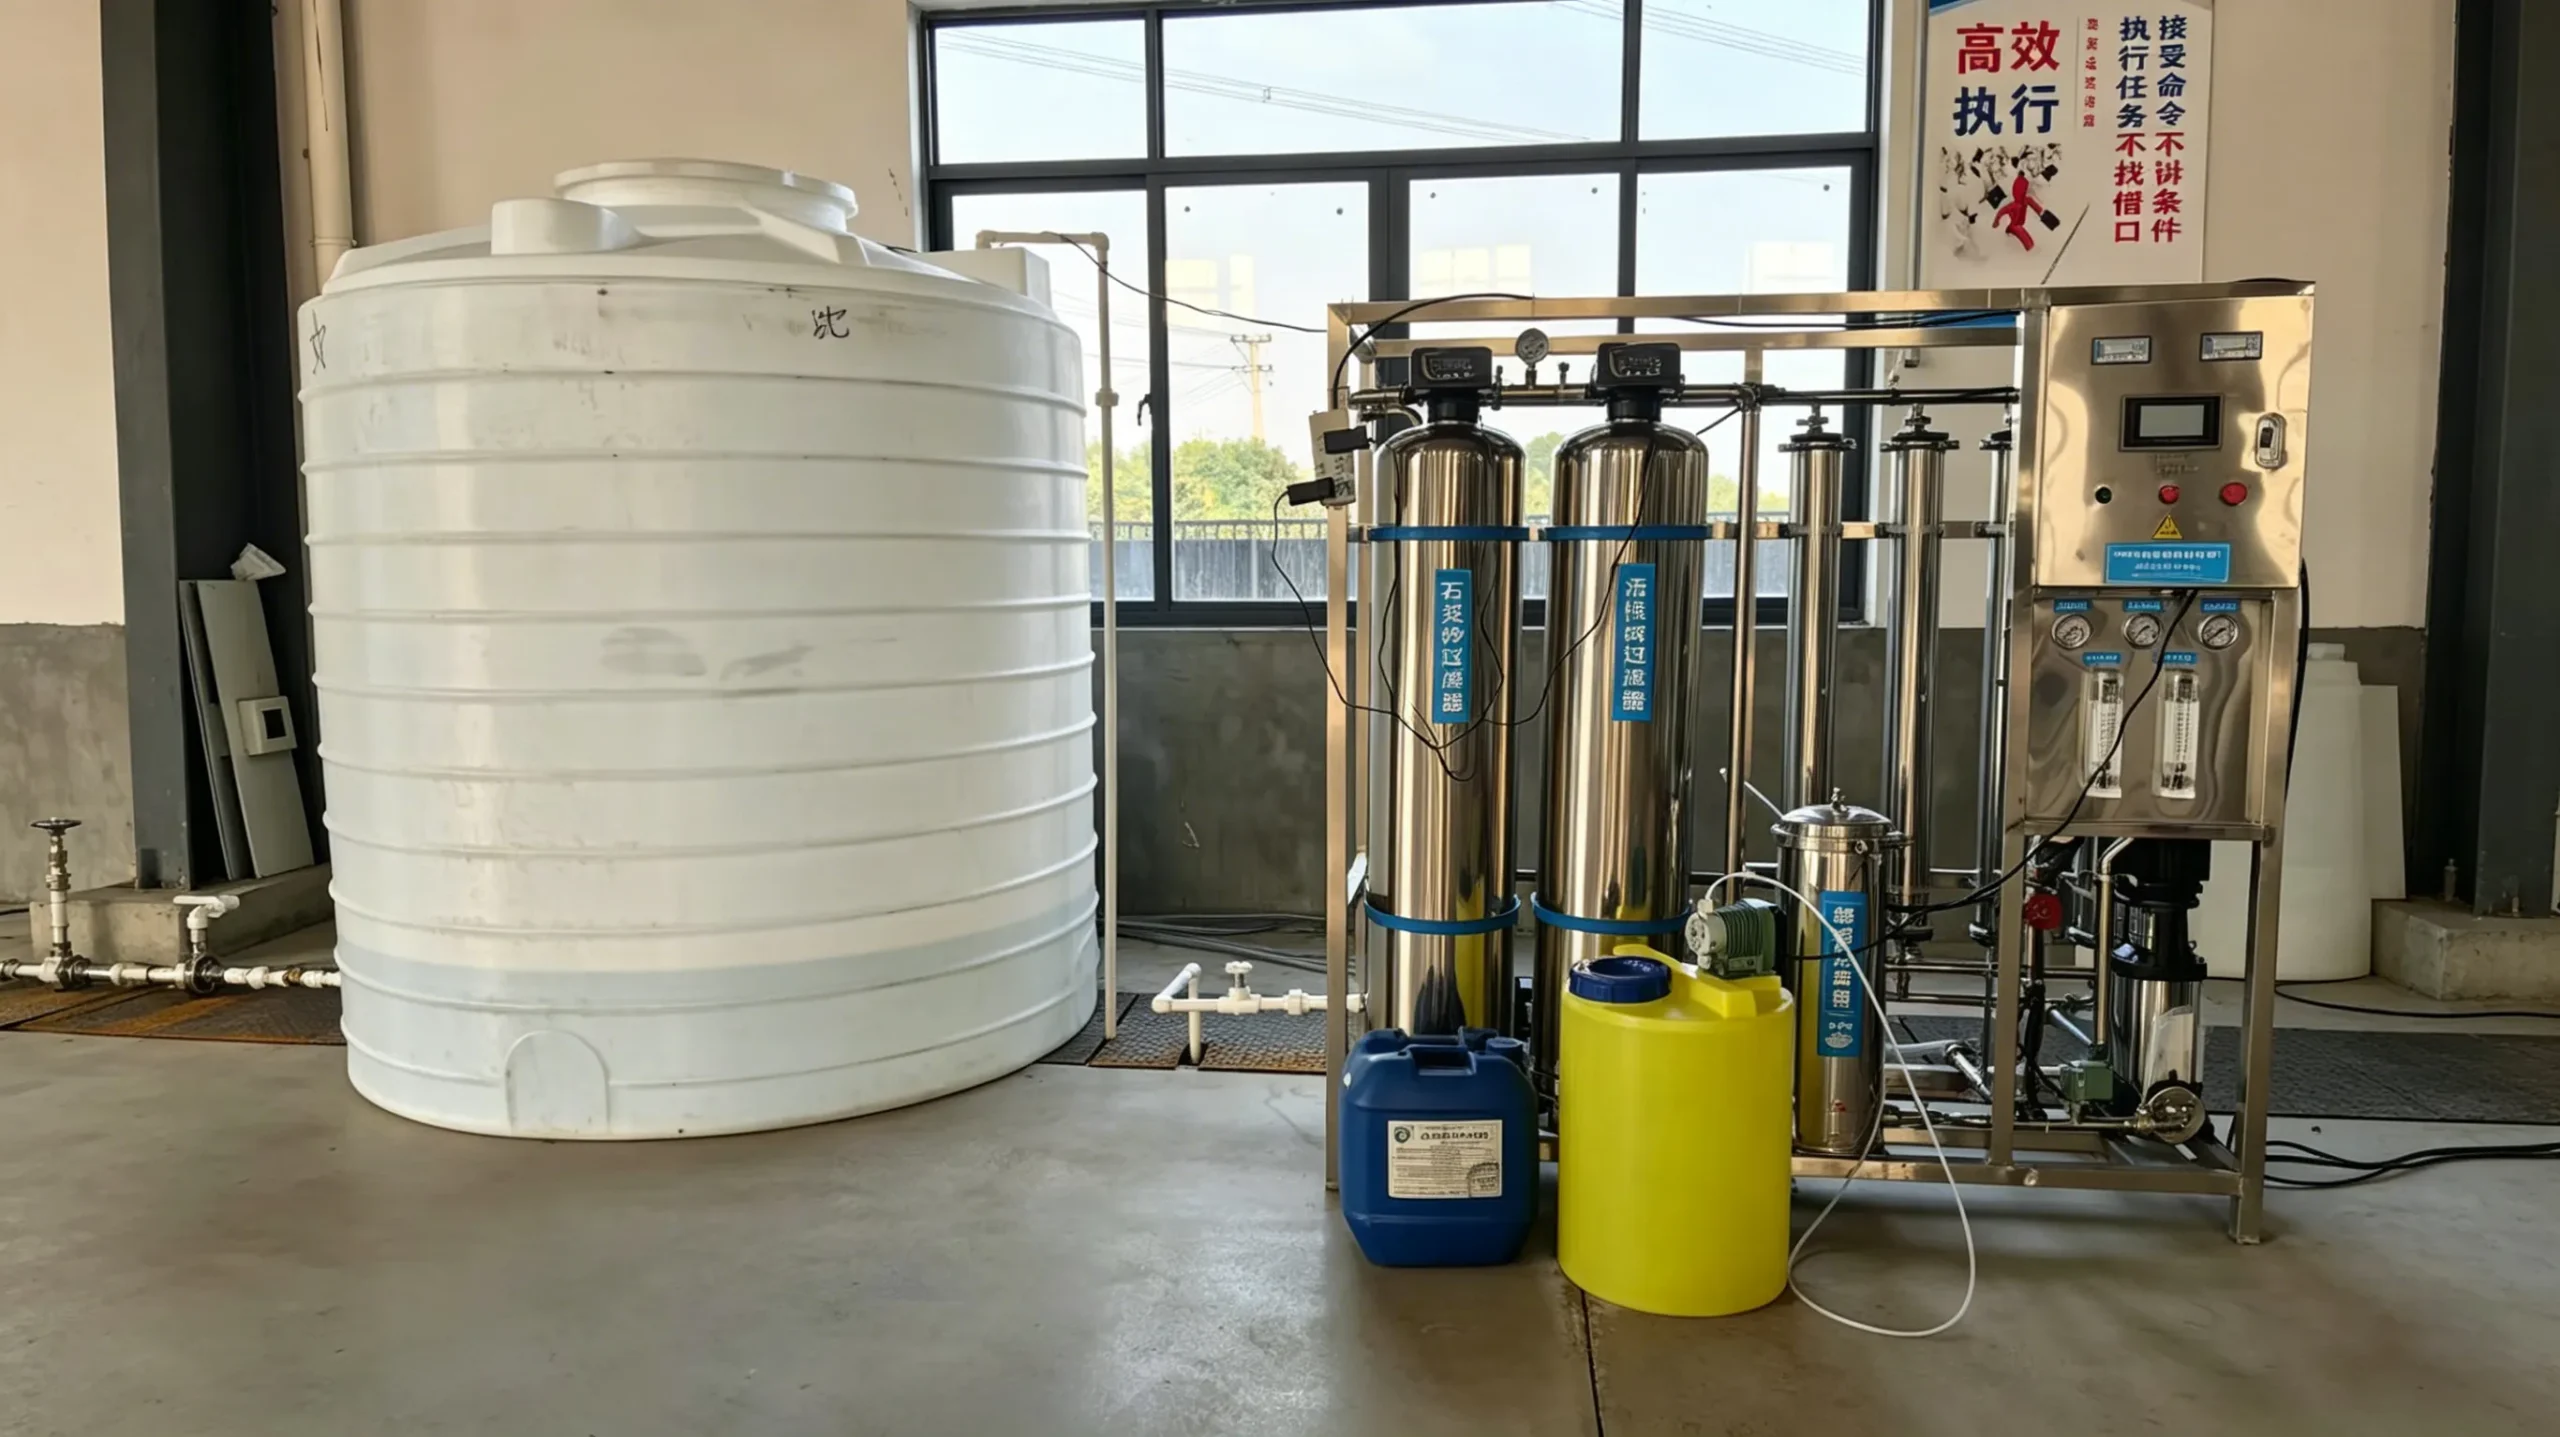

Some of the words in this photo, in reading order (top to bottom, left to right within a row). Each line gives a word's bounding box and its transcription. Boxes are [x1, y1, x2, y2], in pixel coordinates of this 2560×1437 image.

[1952, 83, 2060, 137] 执行
[1956, 20, 2061, 75] 高效
[2113, 15, 2151, 243] 执行任务不找借口
[2150, 14, 2187, 243] 接受命令不讲条件
